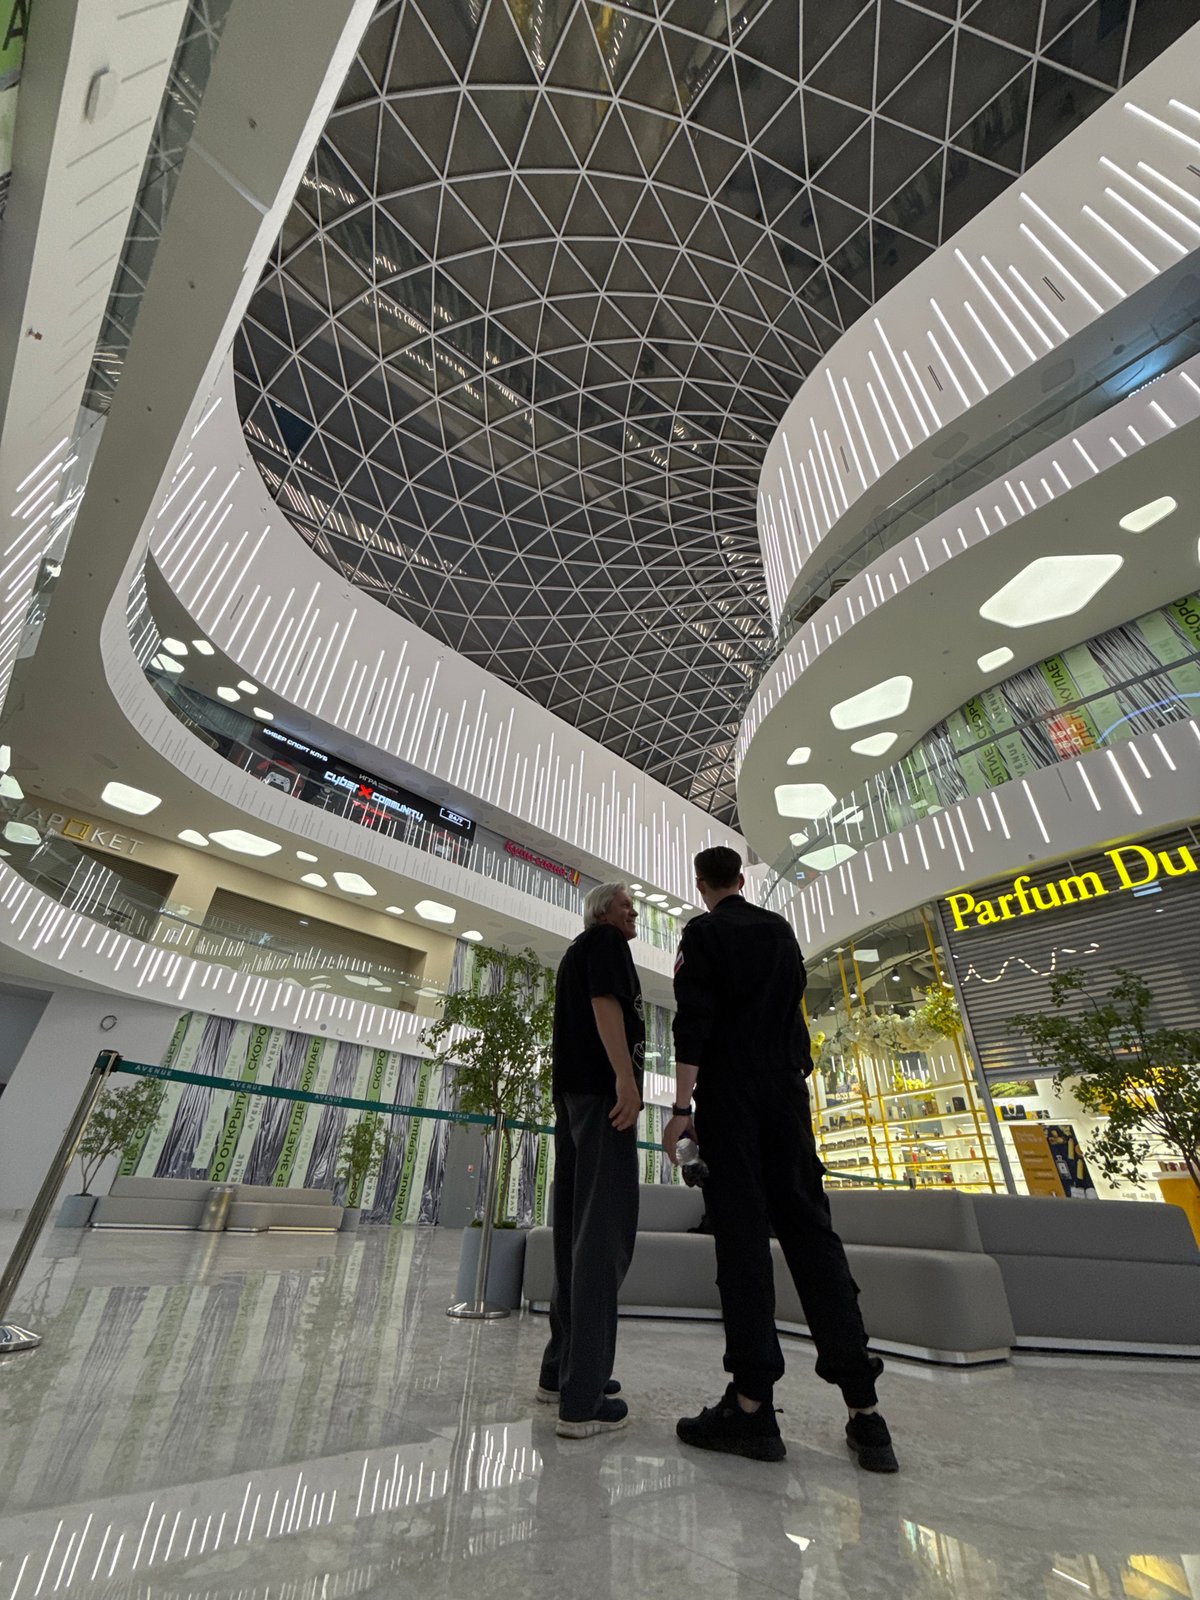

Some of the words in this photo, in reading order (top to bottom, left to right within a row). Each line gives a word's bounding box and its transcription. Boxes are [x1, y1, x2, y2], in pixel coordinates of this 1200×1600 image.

[1006, 742, 1027, 779] VENUE
[944, 868, 1110, 932] Parfum
[266, 1030, 281, 1070] AVENUE
[134, 1065, 173, 1078] AVENUE
[229, 1081, 263, 1092] AVENUE
[293, 1099, 305, 1127] ГДЕ
[302, 1039, 322, 1093] ОКУПАЕТ
[372, 1049, 386, 1090] СКОРО
[220, 1089, 248, 1159] ОТКРЫТИ
[247, 1026, 268, 1071] СКОРО
[314, 1094, 343, 1103] AVENUE
[385, 1105, 411, 1113] AVENUE
[247, 1094, 263, 1130] AVENU
[394, 1172, 409, 1222] AVENUE
[406, 1116, 421, 1163] СЕРДЦЕ
[417, 1073, 428, 1109] ЕВЕРА
